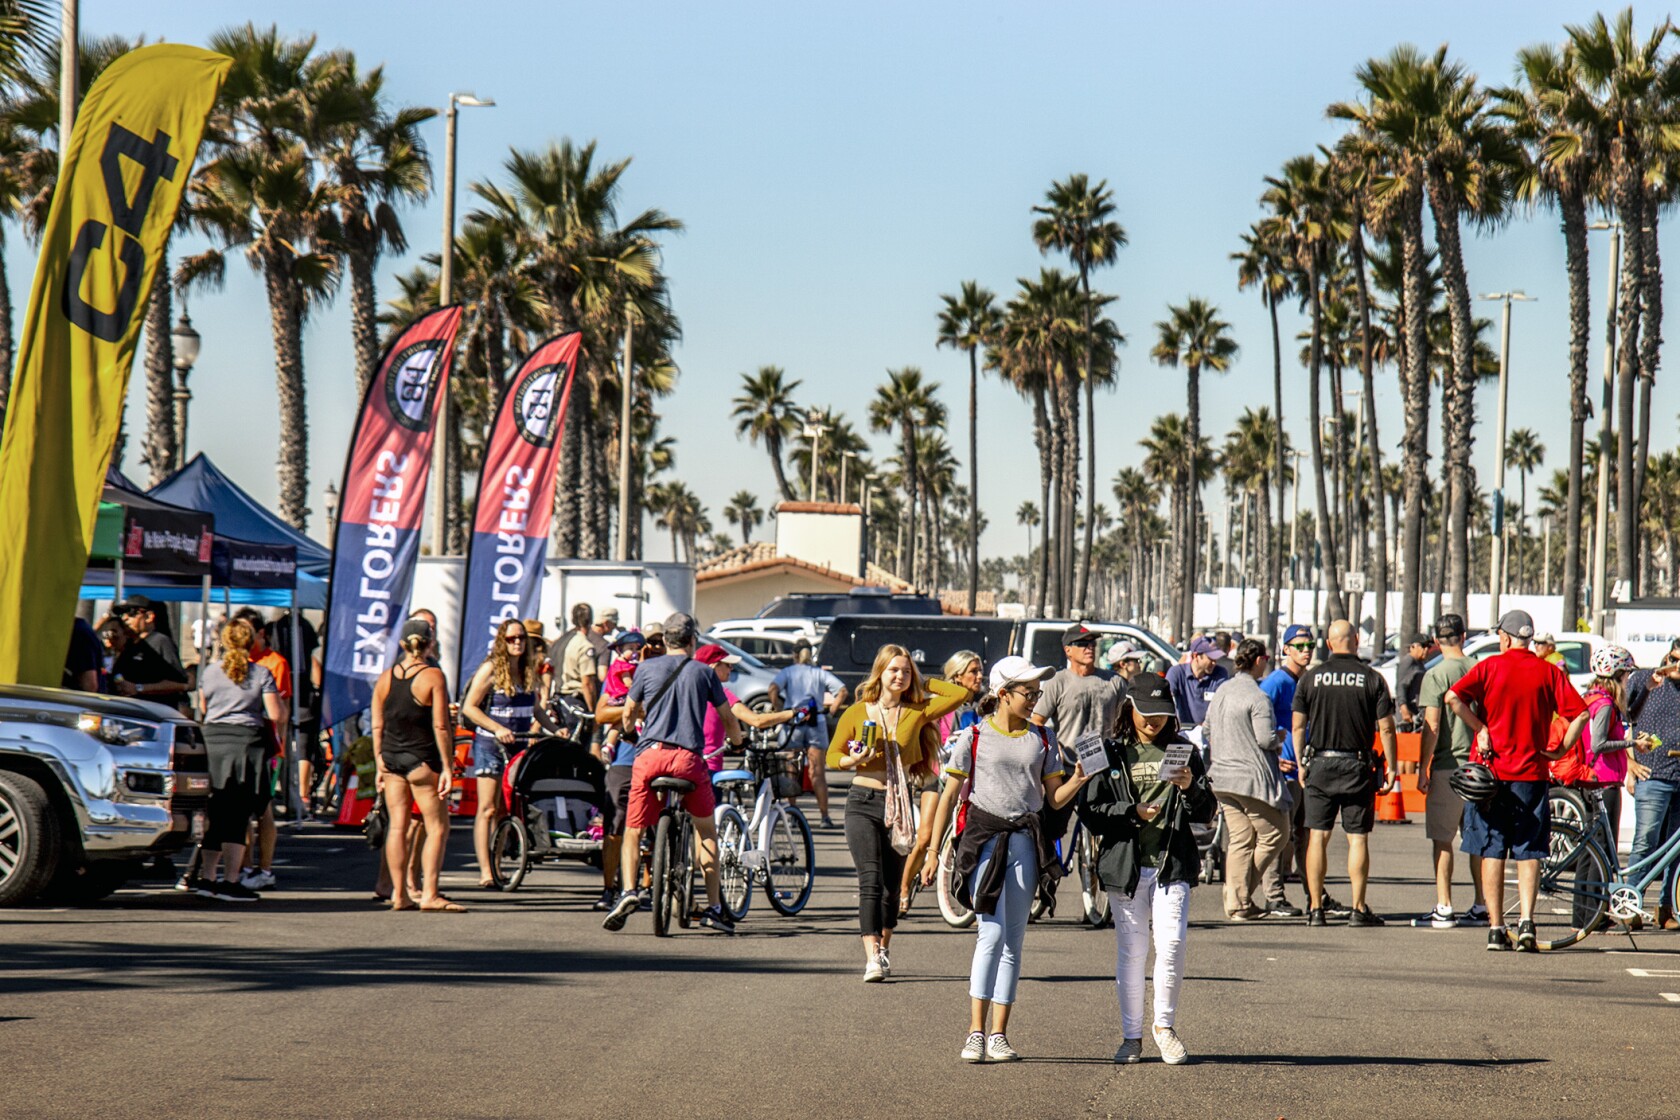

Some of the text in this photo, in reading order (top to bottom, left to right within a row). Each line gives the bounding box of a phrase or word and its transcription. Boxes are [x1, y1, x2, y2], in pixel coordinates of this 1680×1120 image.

[61, 121, 180, 343] C4
[1349, 579, 1361, 589] 15
[1313, 671, 1366, 688] POLICE
